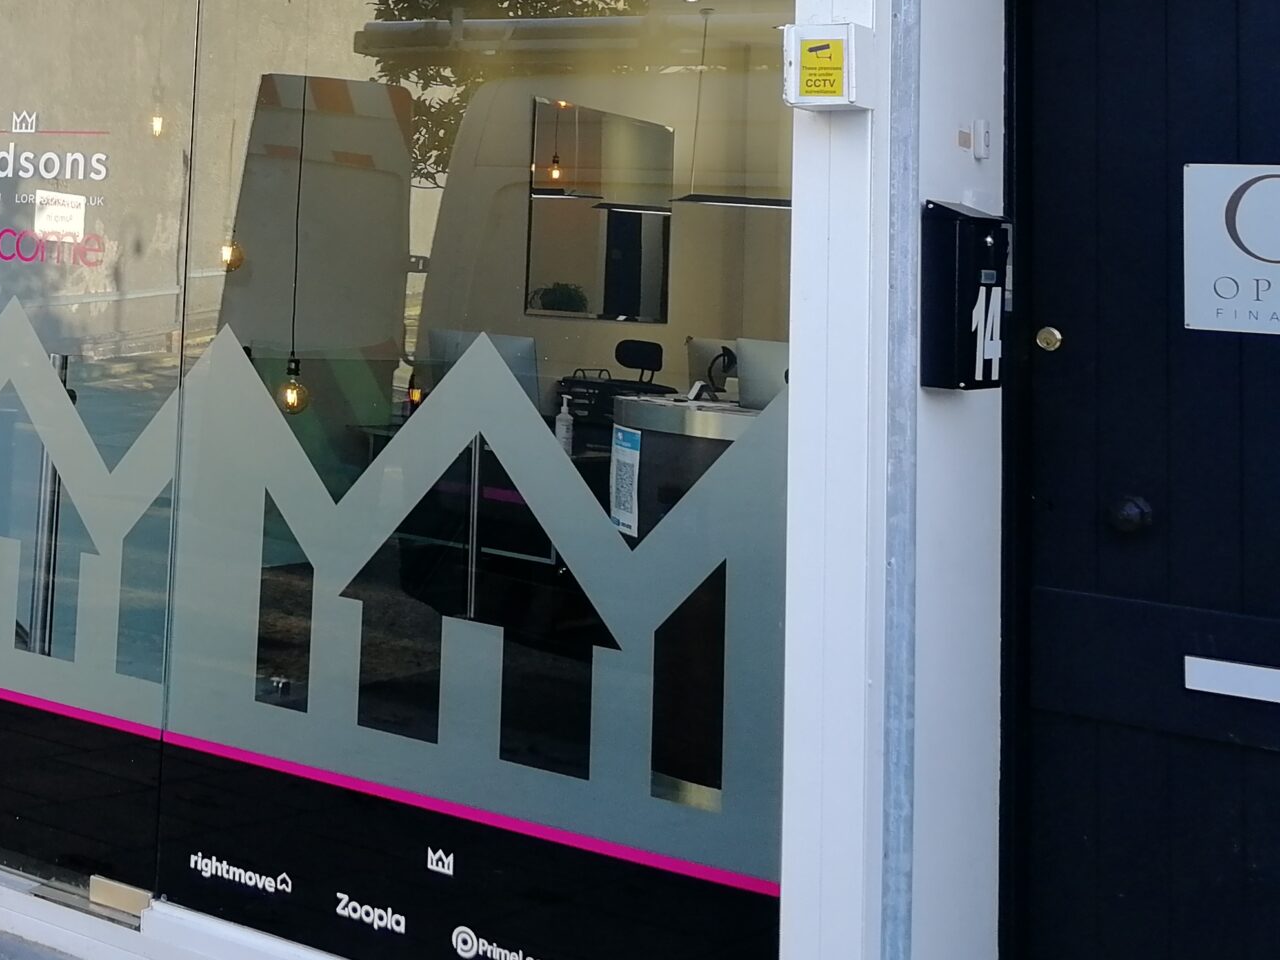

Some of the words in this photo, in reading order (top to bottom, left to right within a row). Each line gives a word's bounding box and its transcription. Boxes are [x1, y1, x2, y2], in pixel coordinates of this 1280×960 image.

[805, 78, 836, 88] CCTV
[971, 286, 1002, 381] 14
[189, 851, 276, 893] rightmove
[335, 892, 407, 934] Zoopla
